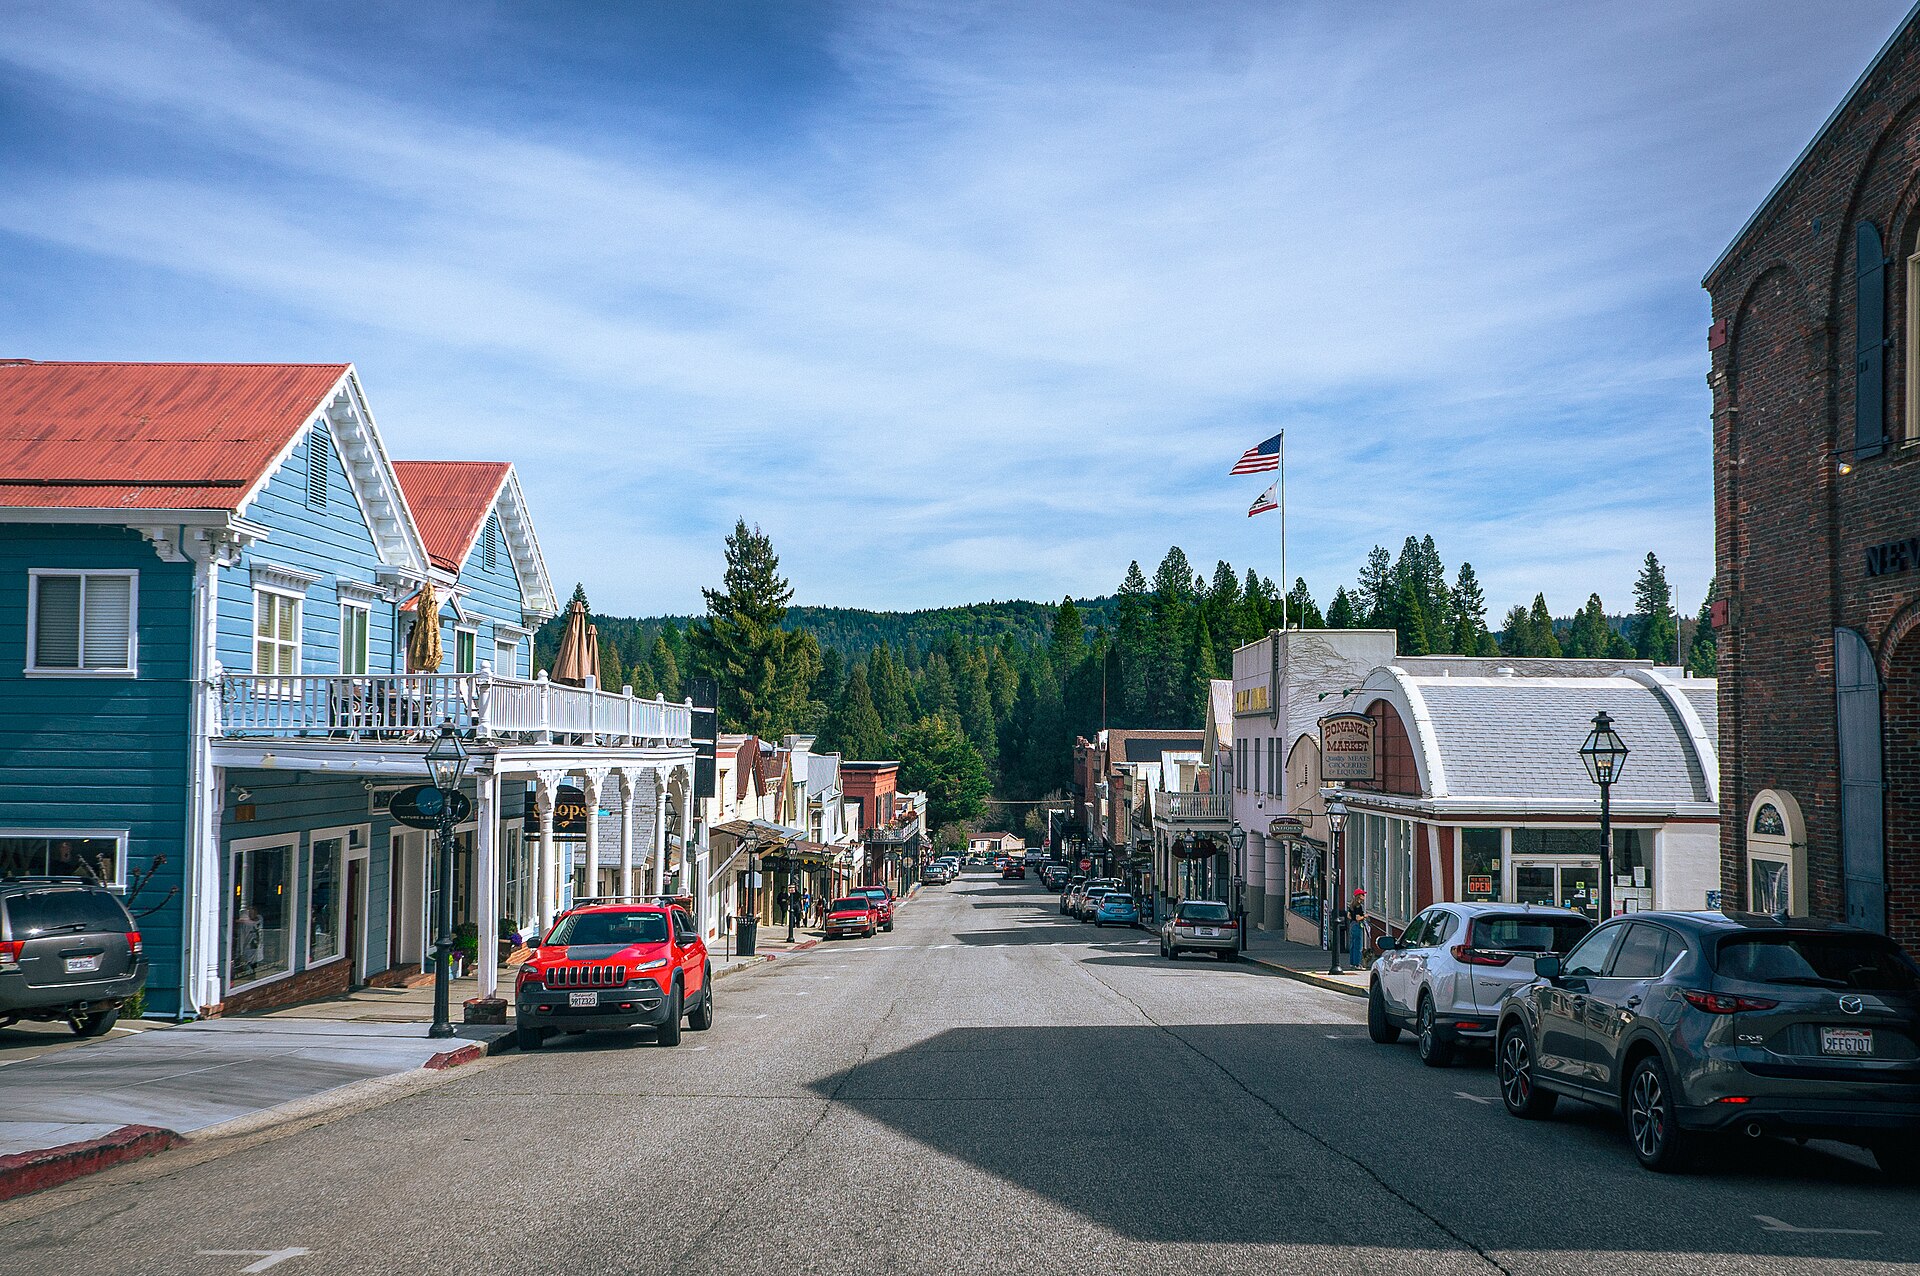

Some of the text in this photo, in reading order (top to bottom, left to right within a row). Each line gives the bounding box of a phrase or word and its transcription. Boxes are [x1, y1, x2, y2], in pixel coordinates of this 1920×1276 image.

[1325, 721, 1369, 740] BONANZA
[1326, 741, 1368, 752] MARKET
[533, 803, 588, 820] Sops
[1470, 882, 1490, 892] OPEN
[1826, 1037, 1870, 1051] 9FFG707
